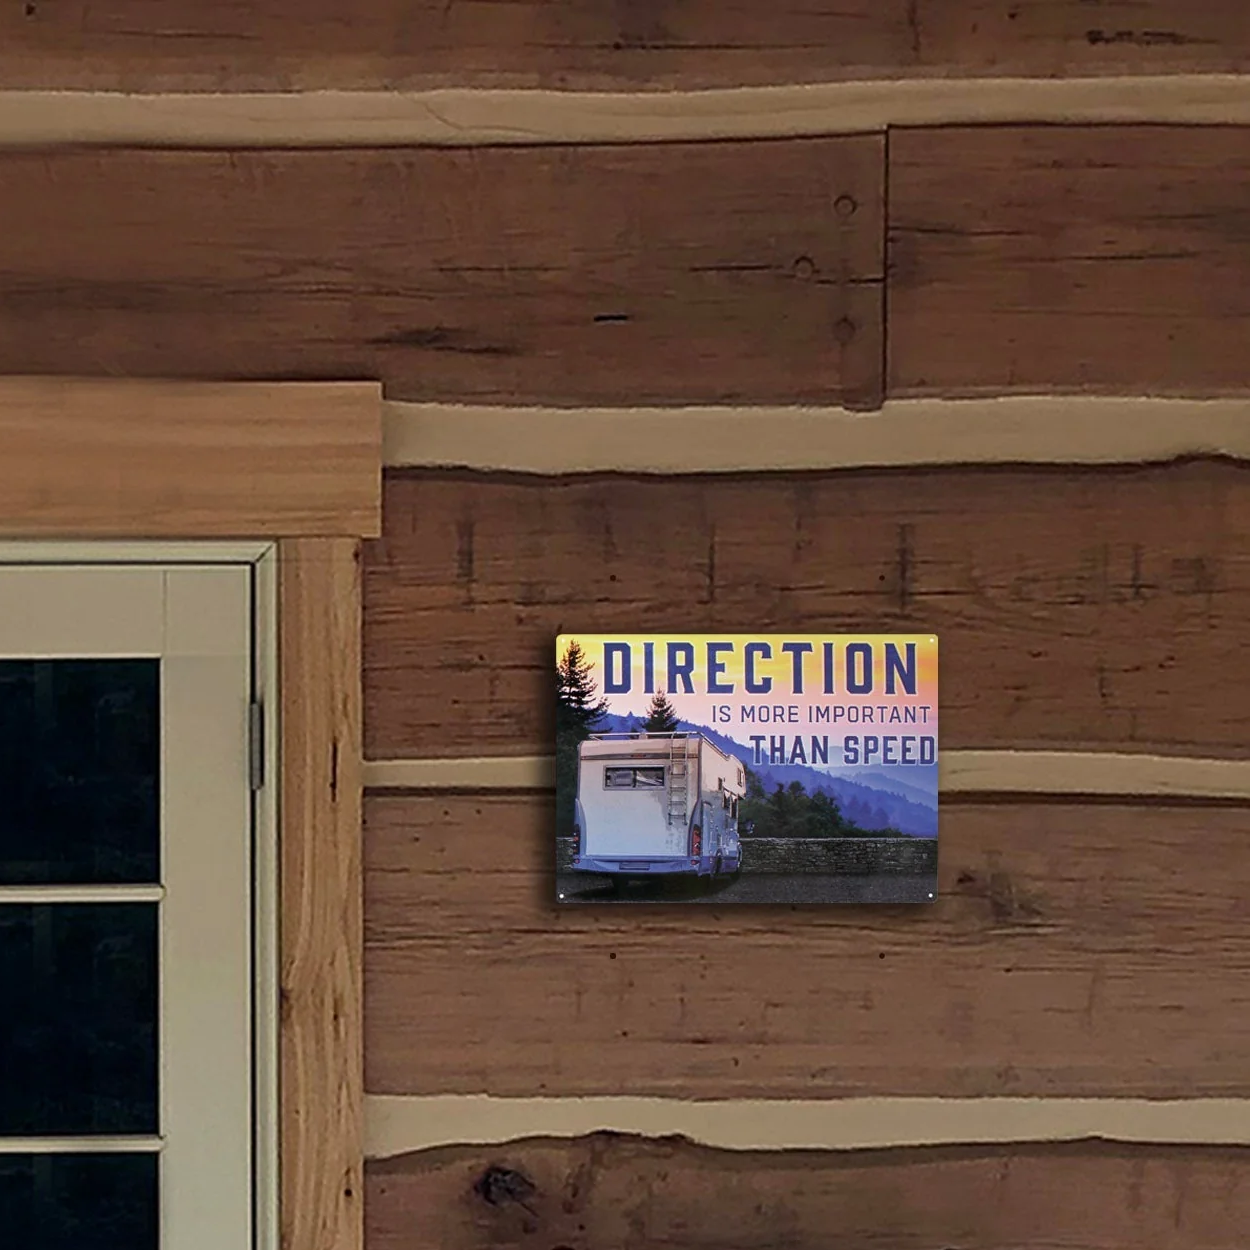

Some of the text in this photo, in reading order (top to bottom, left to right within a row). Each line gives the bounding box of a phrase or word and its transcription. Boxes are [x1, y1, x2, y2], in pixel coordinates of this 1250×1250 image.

[602, 641, 917, 695] DIRECTION
[711, 704, 931, 724] IS MORE IMPORTANT
[750, 735, 935, 765] THAN SPEED
